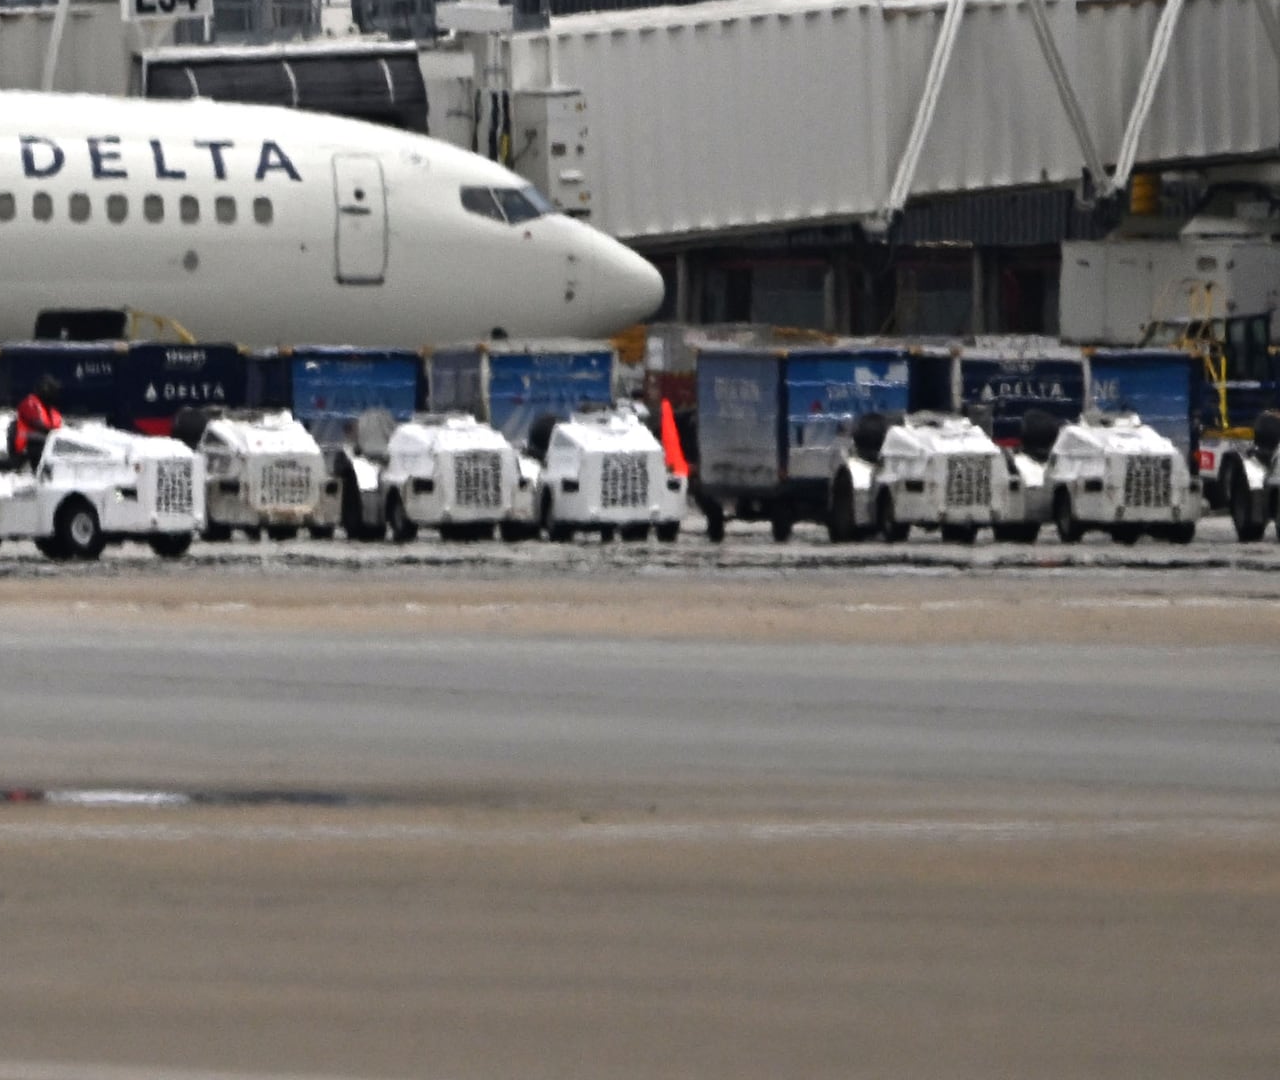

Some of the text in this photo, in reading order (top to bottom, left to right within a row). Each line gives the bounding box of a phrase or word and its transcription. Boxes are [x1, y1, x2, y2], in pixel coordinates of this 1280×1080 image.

[18, 133, 302, 182] DELTA
[163, 383, 225, 401] DELTA
[998, 380, 1065, 399] DELTA
